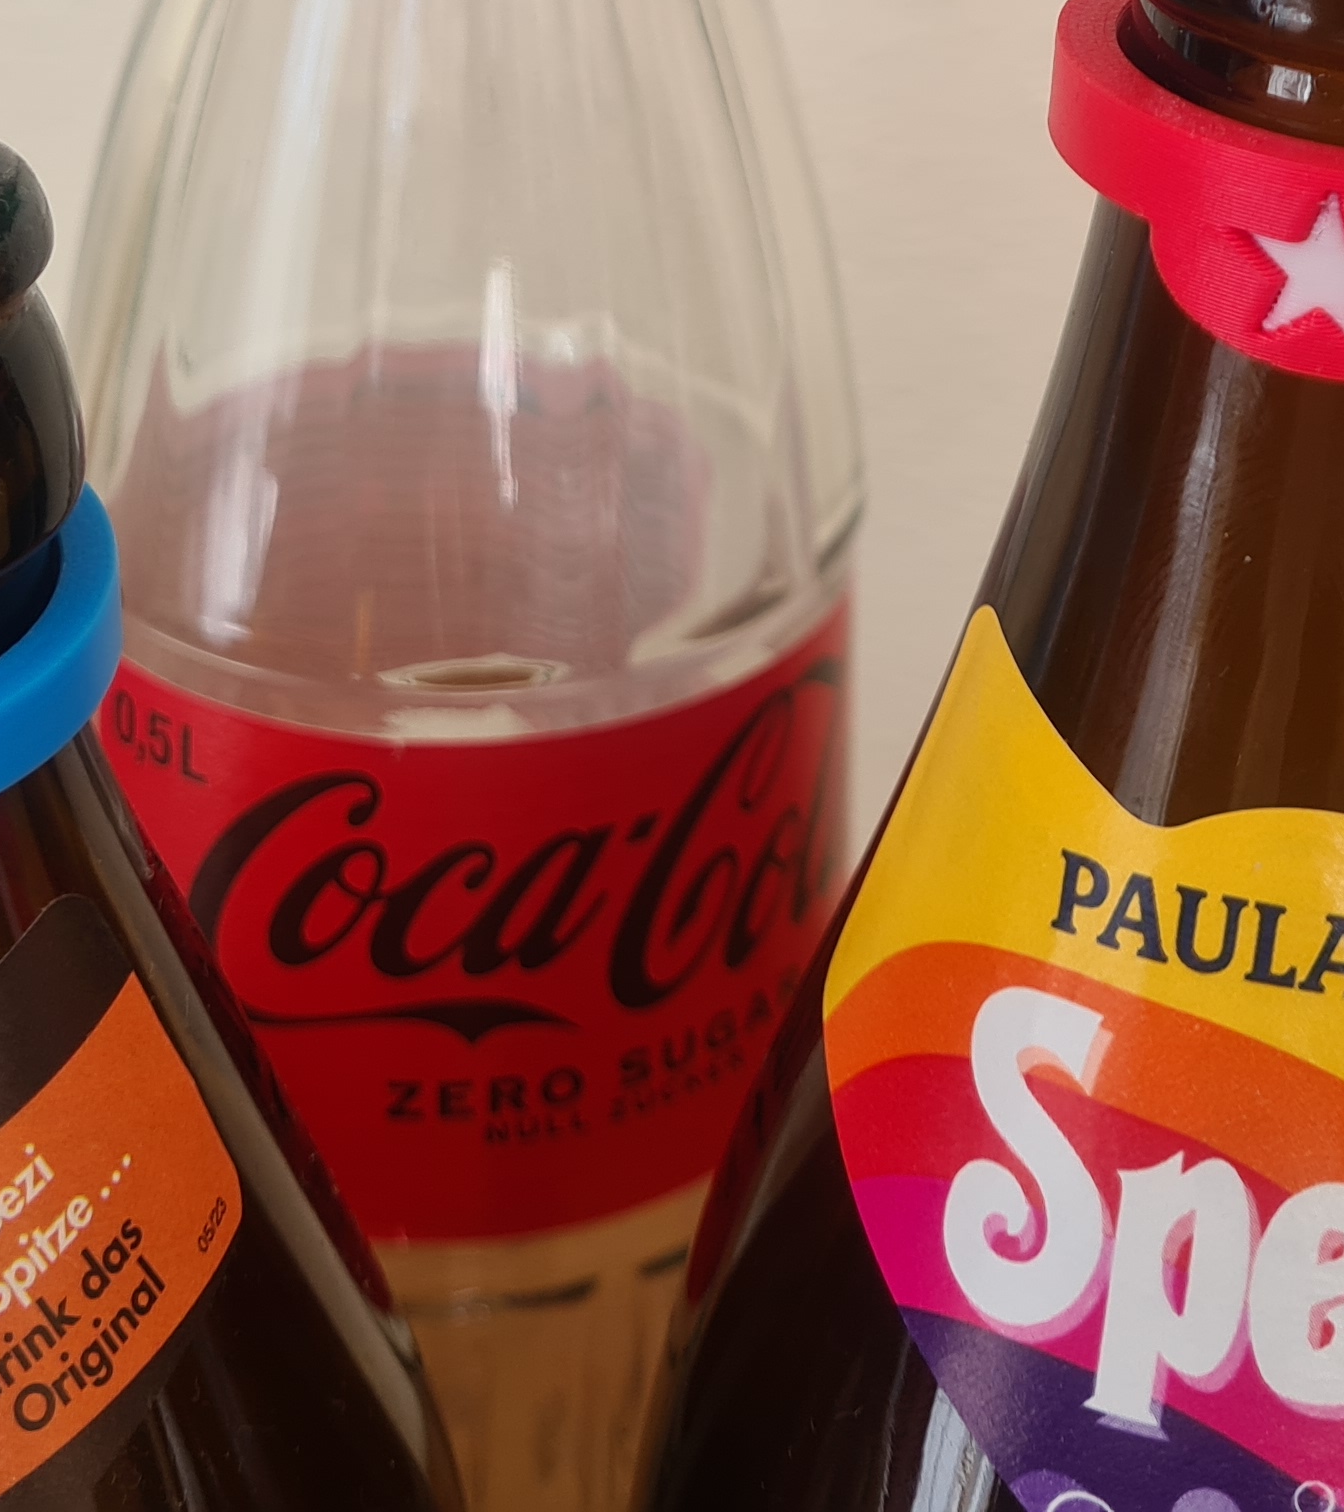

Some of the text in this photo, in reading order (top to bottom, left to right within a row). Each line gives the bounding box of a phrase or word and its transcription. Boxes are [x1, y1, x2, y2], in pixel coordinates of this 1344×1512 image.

[385, 1066, 586, 1122] ZERO
[80, 1217, 144, 1301] das
[196, 1195, 228, 1255] 05/23
[12, 1253, 167, 1433] Original
